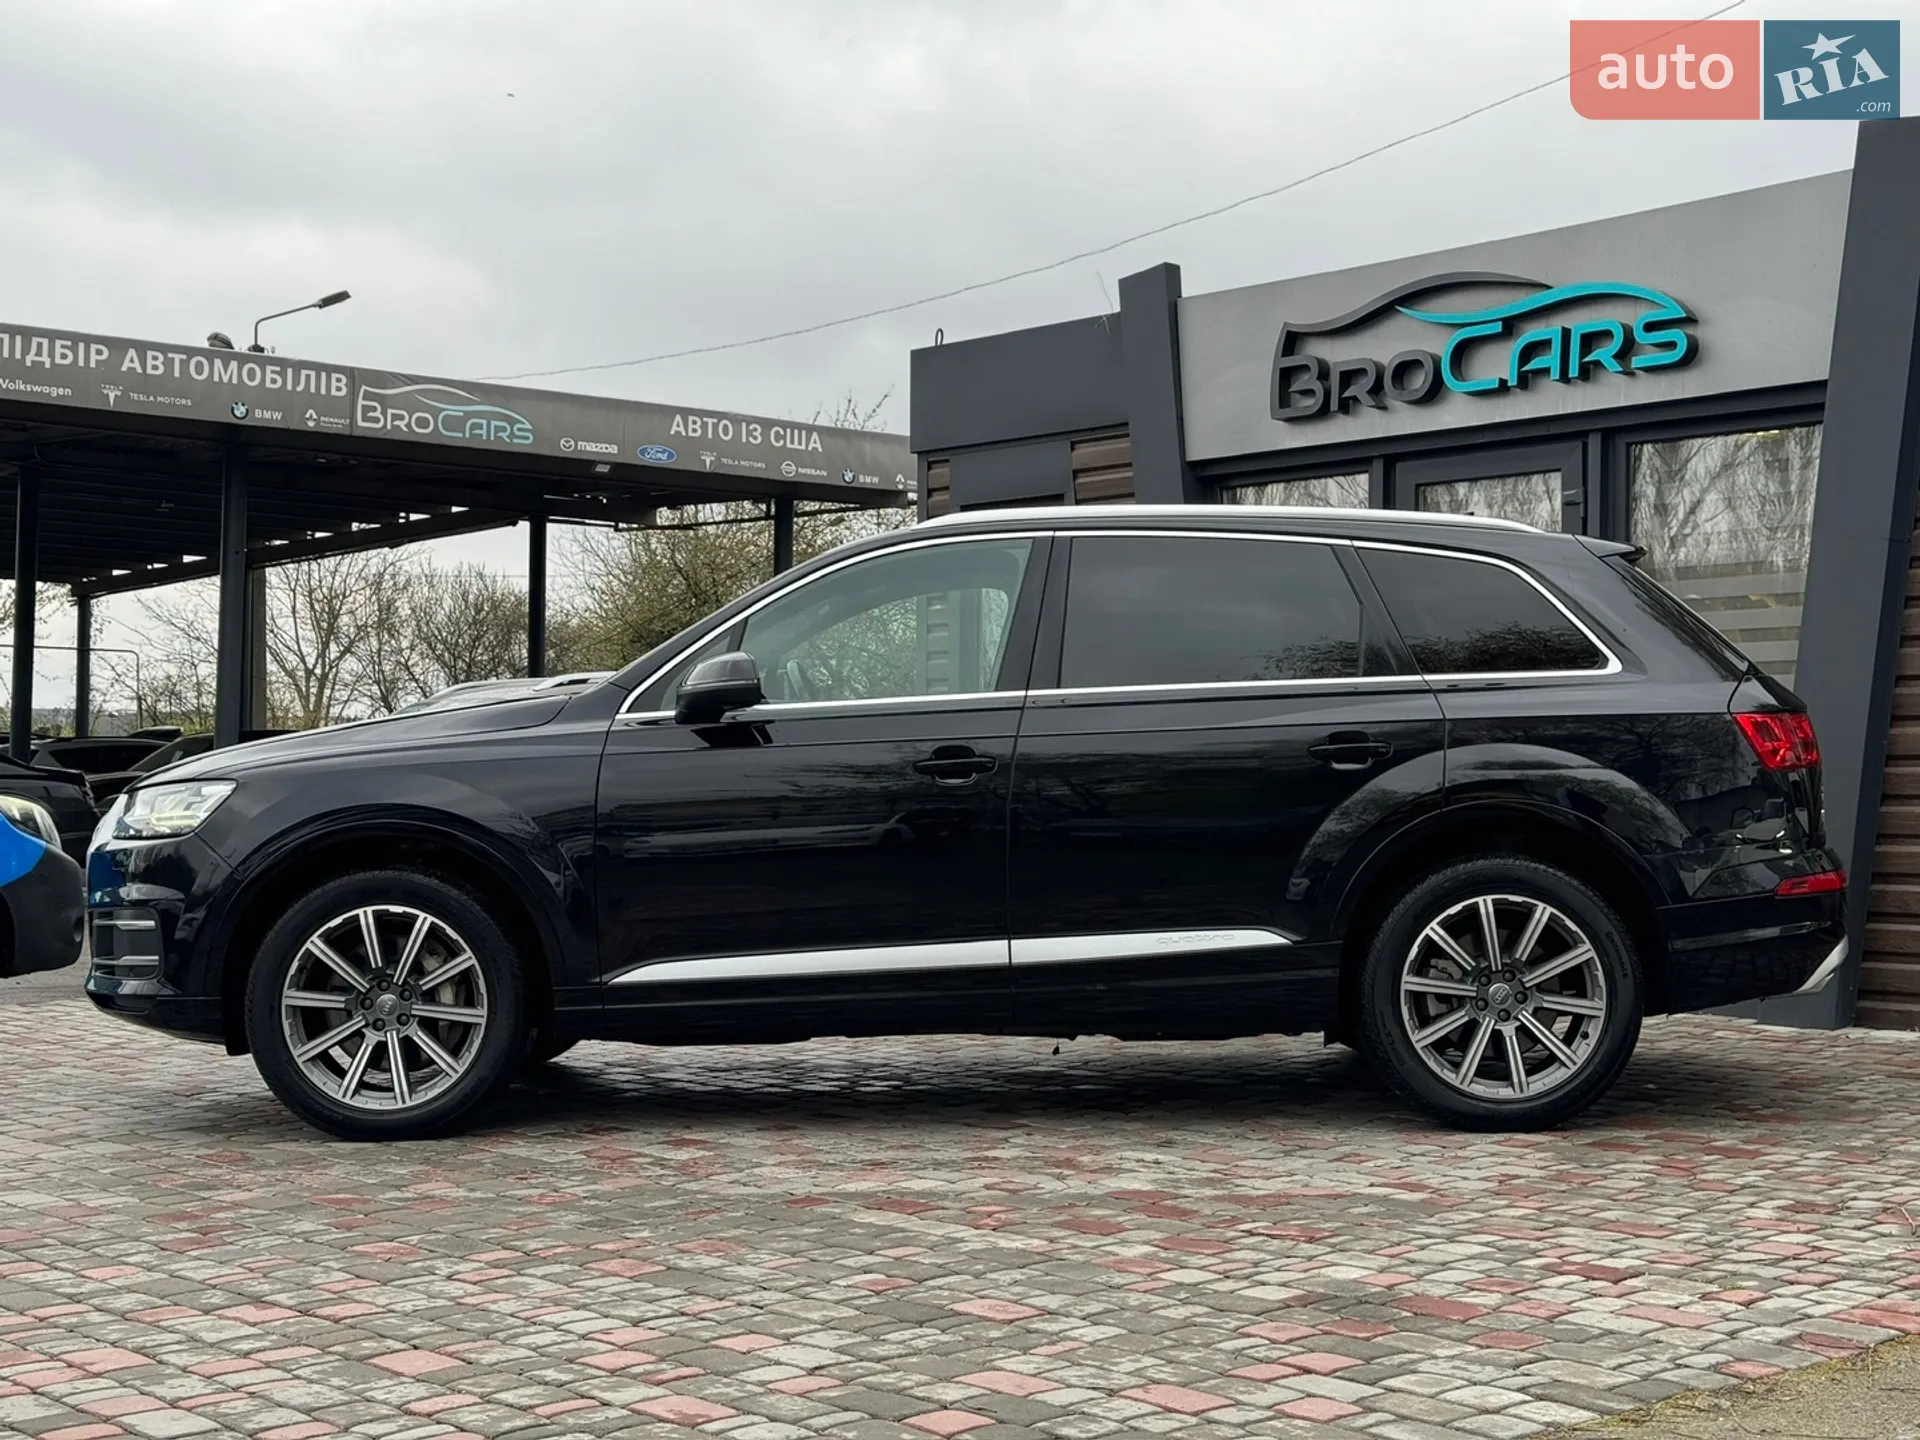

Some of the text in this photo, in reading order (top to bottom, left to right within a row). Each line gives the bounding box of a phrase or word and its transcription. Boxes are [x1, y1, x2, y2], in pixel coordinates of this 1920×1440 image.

[120, 347, 348, 398] АВТОМОБІЛІВ
[0, 379, 72, 398] Volkswagen
[129, 391, 192, 406] TESLA MOTORS
[254, 408, 283, 420] BMW
[669, 413, 823, 453] АВТО ІЗ США
[577, 440, 618, 454] mazda
[643, 447, 669, 461] Ford
[798, 466, 828, 477] NISSAN
[858, 474, 880, 485] BMW
[1156, 934, 1236, 947] quattro
